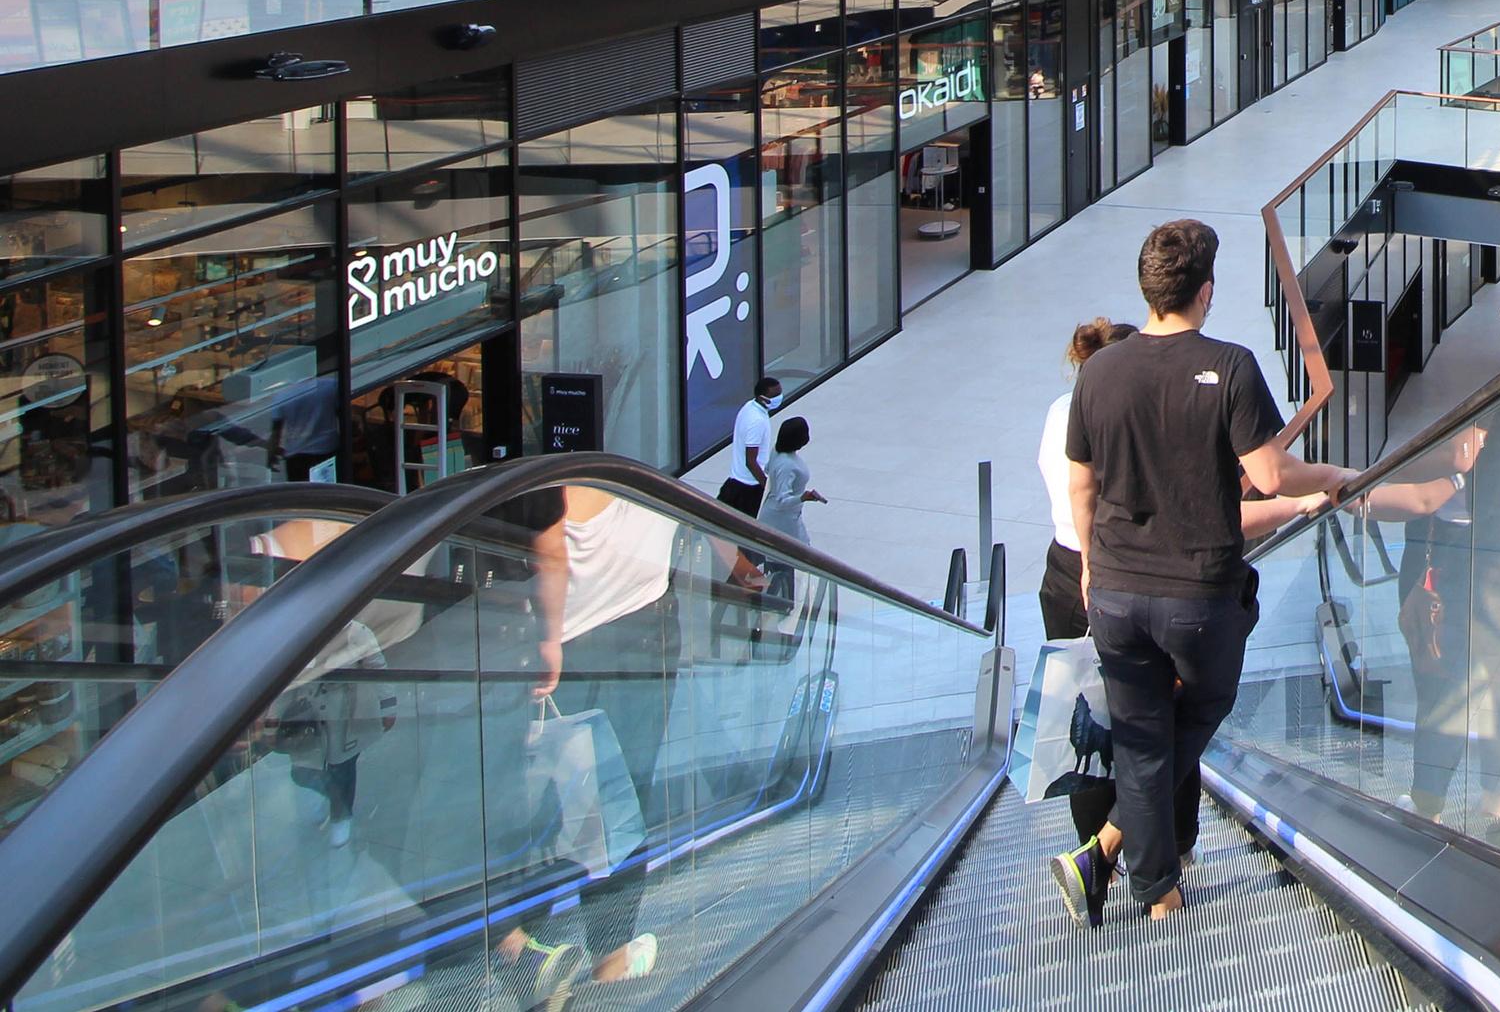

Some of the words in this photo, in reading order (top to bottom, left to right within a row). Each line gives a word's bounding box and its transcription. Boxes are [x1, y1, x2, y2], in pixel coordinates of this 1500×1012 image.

[899, 59, 977, 120] okaïdi
[383, 232, 457, 281] muy
[383, 251, 498, 316] mucho
[553, 422, 580, 435] nice
[553, 435, 565, 448] &
